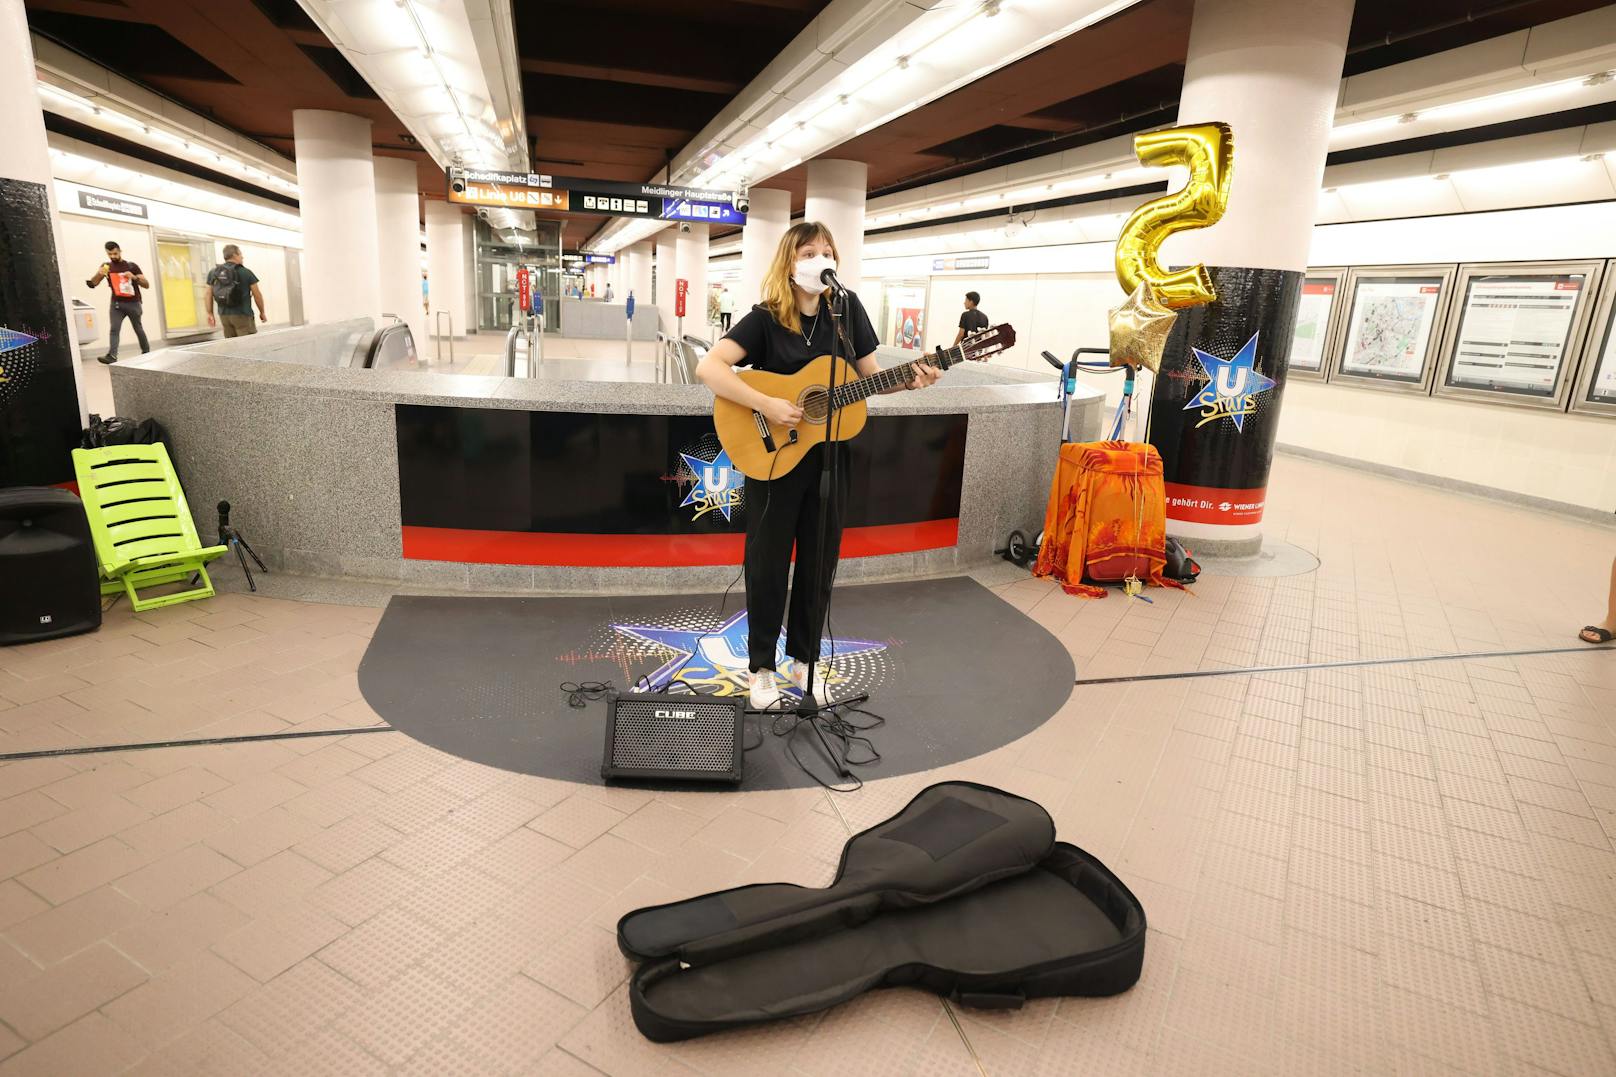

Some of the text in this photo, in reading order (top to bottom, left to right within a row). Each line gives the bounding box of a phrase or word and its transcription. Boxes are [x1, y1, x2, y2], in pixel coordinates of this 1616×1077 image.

[480, 189, 526, 202] Linie U6
[641, 186, 732, 202] Meidlinger Hauptstraße
[1216, 365, 1247, 397] U
[1199, 391, 1256, 417] Stars
[703, 466, 729, 493] U
[691, 489, 740, 512] Stars
[1172, 497, 1198, 508] gehört
[1200, 501, 1214, 510] Dir.
[654, 710, 697, 720] CUBE
